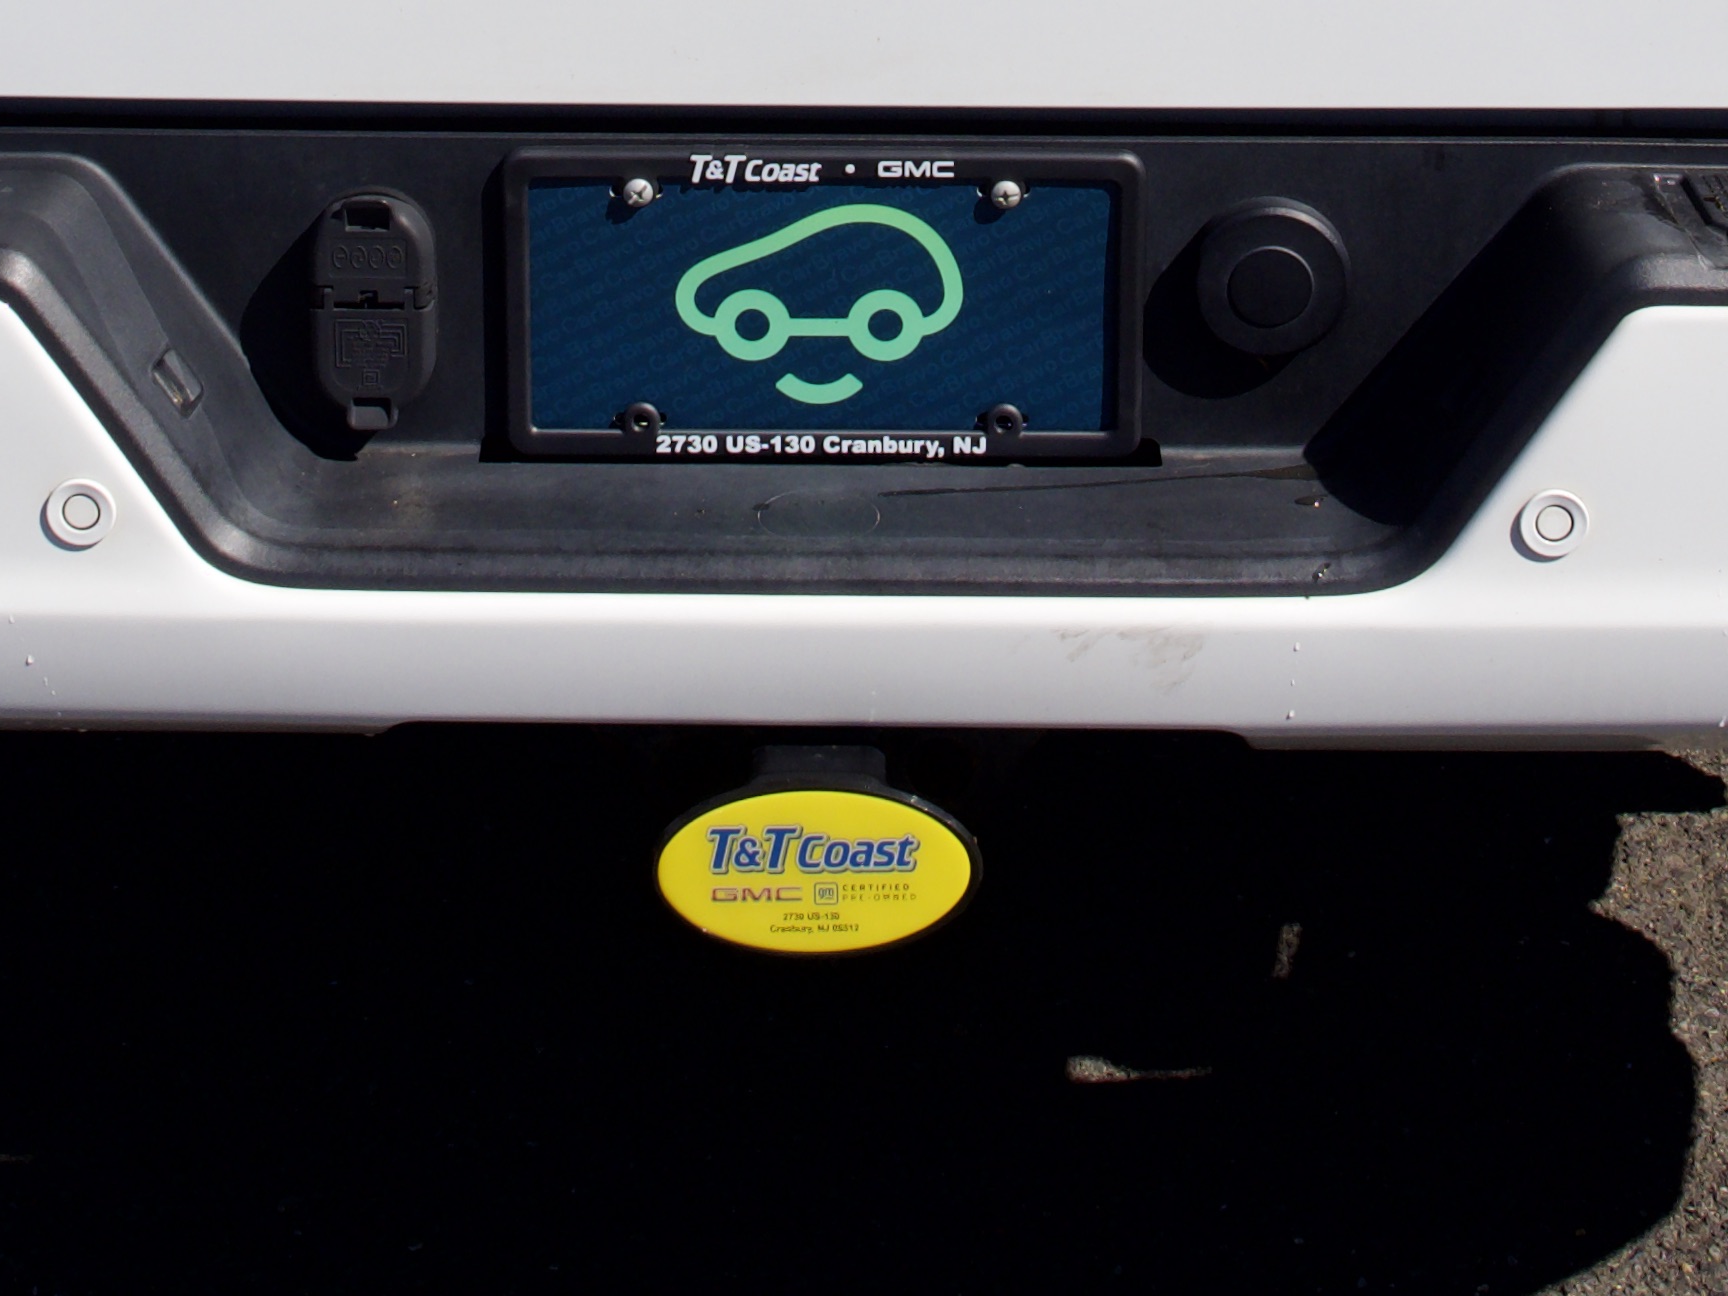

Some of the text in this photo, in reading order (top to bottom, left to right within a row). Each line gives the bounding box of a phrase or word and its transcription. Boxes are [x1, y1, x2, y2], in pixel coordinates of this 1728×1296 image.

[689, 154, 955, 183] T&T Coast GMC
[655, 436, 987, 459] 2730 US-130 Cranbury, NJ
[706, 824, 921, 875] T&T Coast
[710, 887, 804, 903] GMC
[842, 883, 910, 891] CERTIFIED
